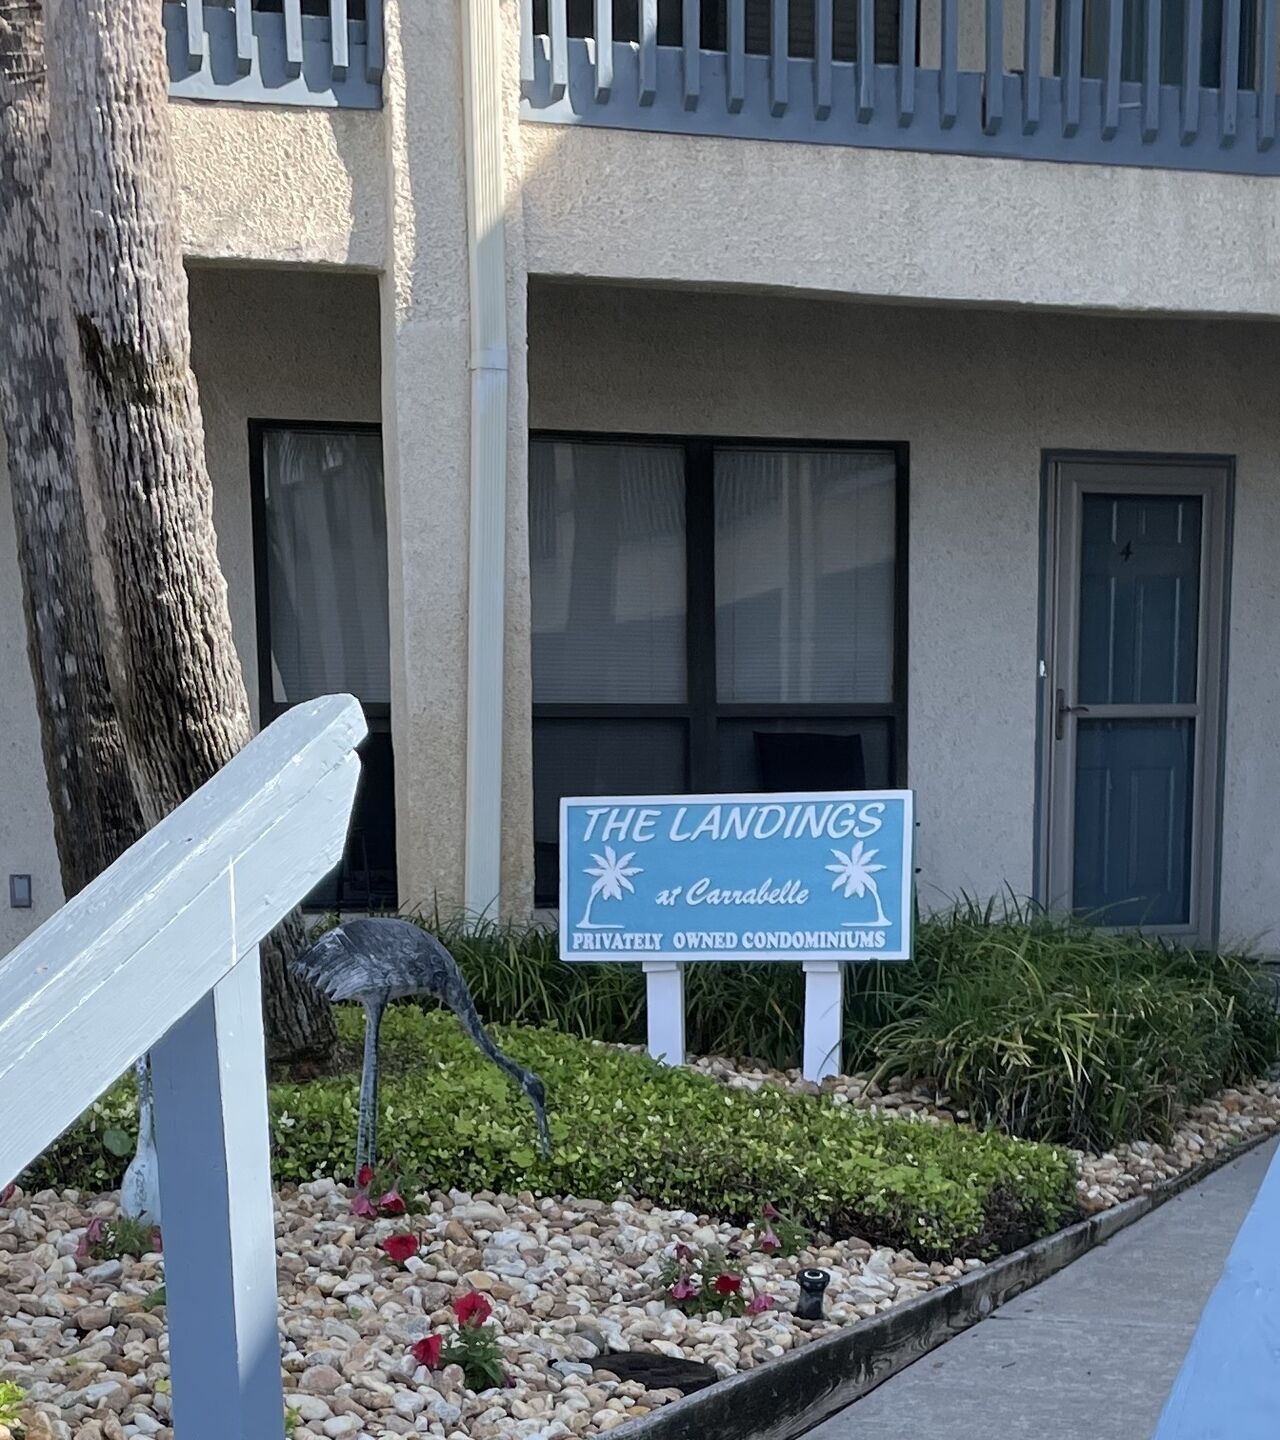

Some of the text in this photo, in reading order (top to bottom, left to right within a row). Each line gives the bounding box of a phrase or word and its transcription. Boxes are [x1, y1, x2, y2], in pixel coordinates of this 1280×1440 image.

[1120, 540, 1133, 562] 4
[583, 802, 886, 842] THE LANDINGS
[655, 878, 809, 906] at Carrabelle
[572, 930, 886, 950] PRIVATELY OWNED CONDOMINIUMS
